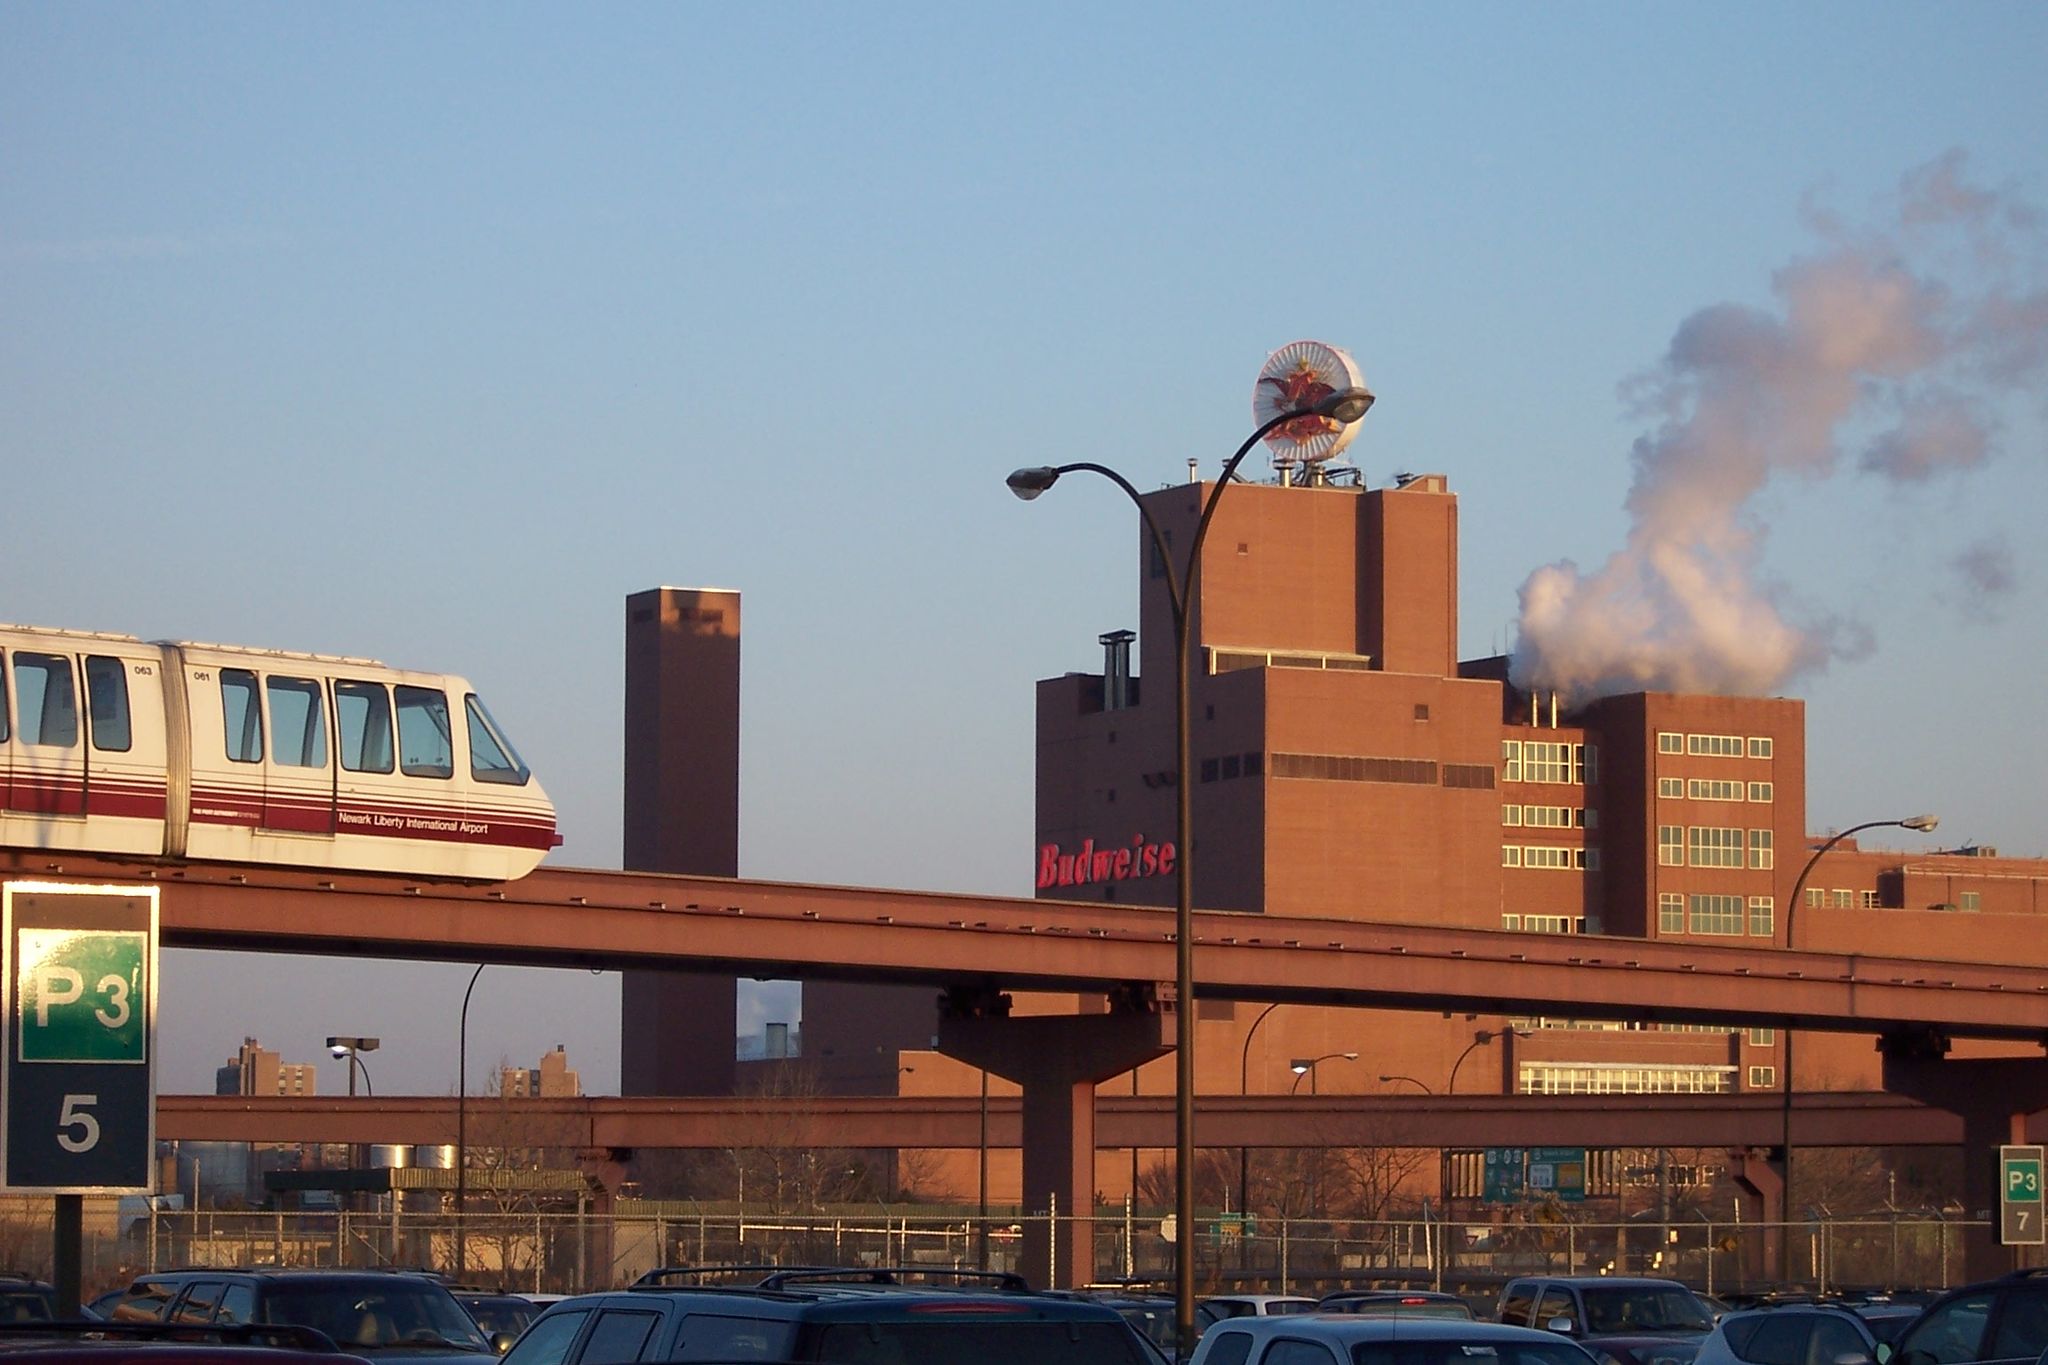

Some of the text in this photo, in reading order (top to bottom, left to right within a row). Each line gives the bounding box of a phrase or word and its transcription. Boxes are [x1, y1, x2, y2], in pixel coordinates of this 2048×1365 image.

[134, 666, 152, 675] 063
[194, 672, 210, 681] 061
[338, 812, 489, 835] Newark Liberty International Airport
[1037, 833, 1177, 888] Budweise
[56, 1094, 101, 1153] 5
[2017, 1212, 2029, 1230] 7
